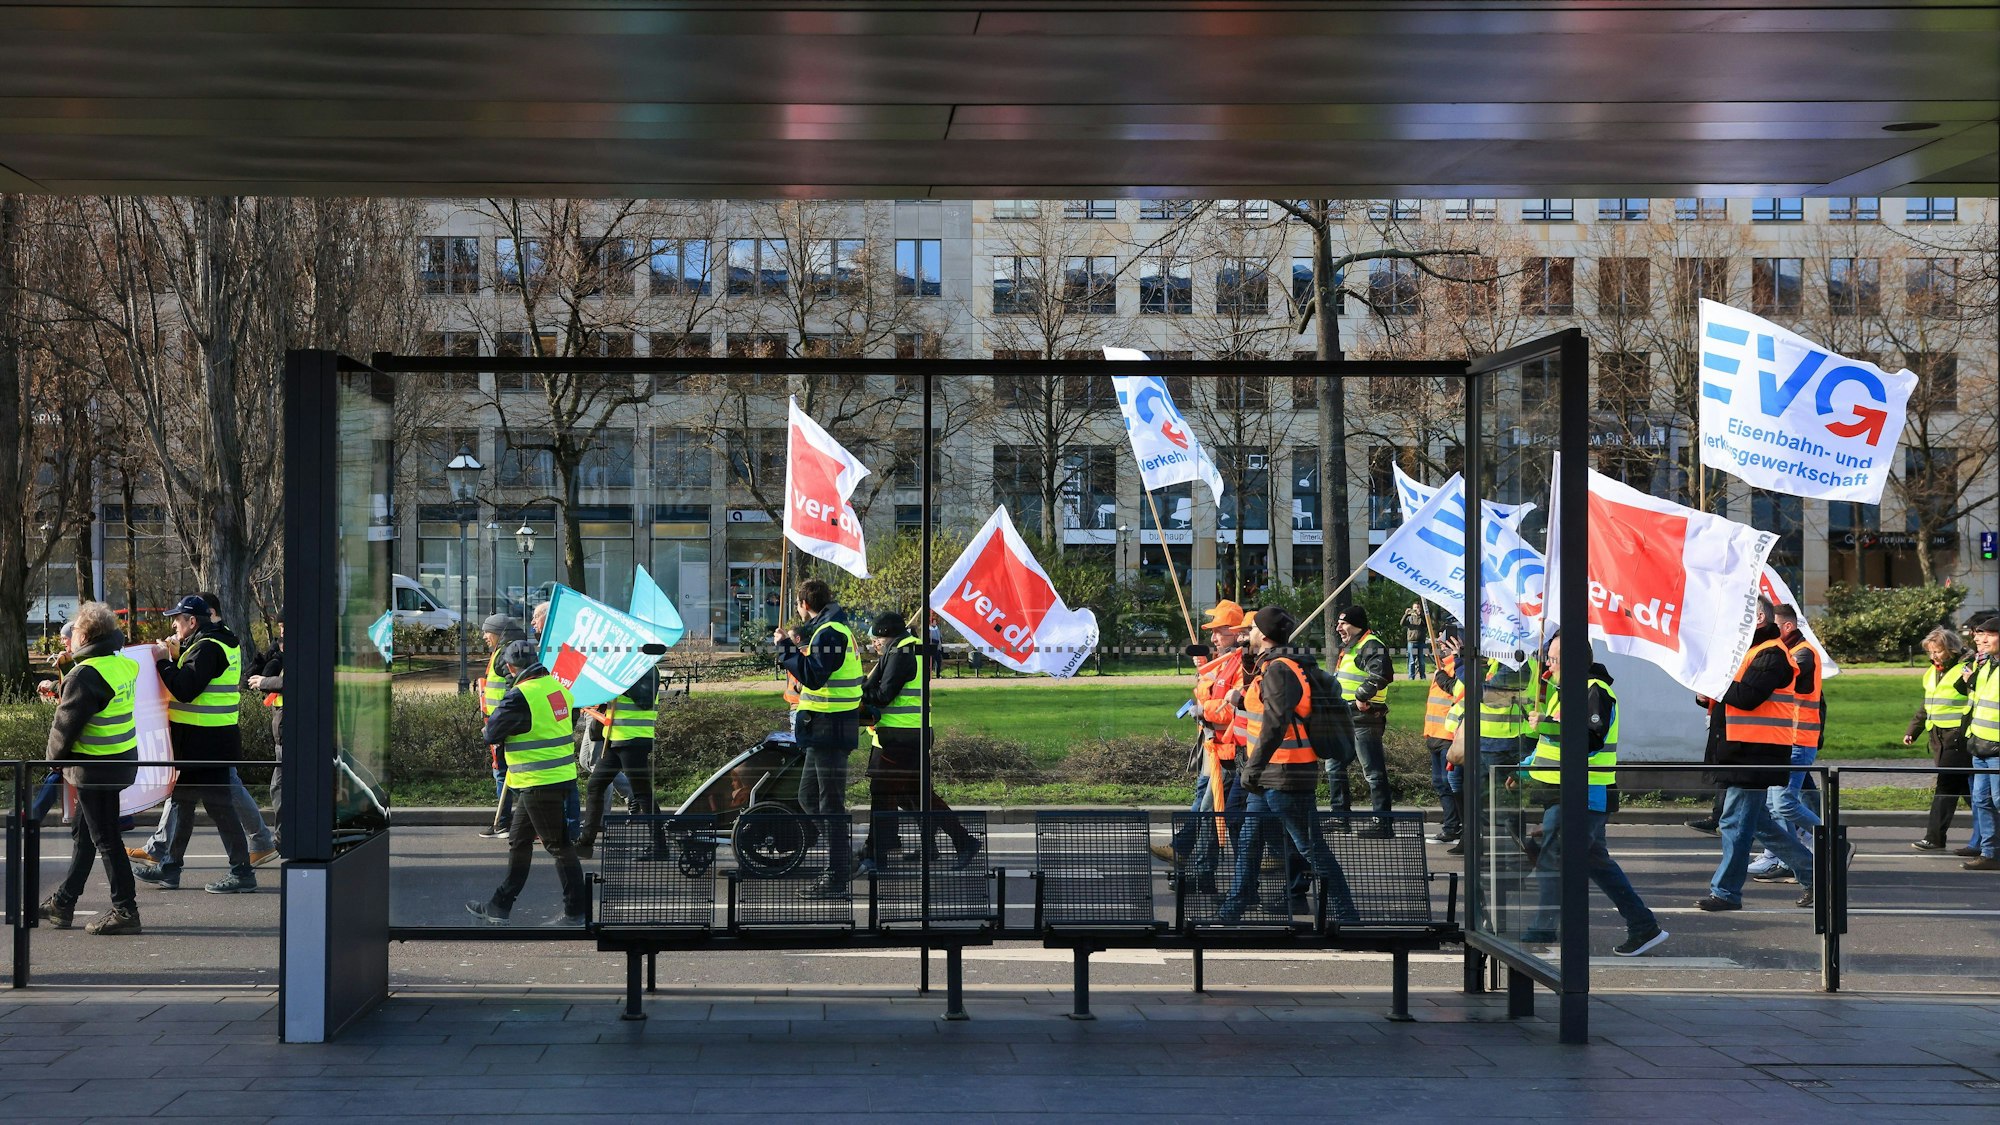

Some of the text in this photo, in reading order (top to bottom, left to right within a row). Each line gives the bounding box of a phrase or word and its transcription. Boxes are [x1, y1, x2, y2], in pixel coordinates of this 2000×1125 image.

[1703, 321, 1888, 447] EVG
[1728, 417, 1873, 469] Eisenbahn- und
[960, 579, 1035, 655] ver.di
[1588, 577, 1676, 637] er.di
[301, 869, 308, 878] 3
